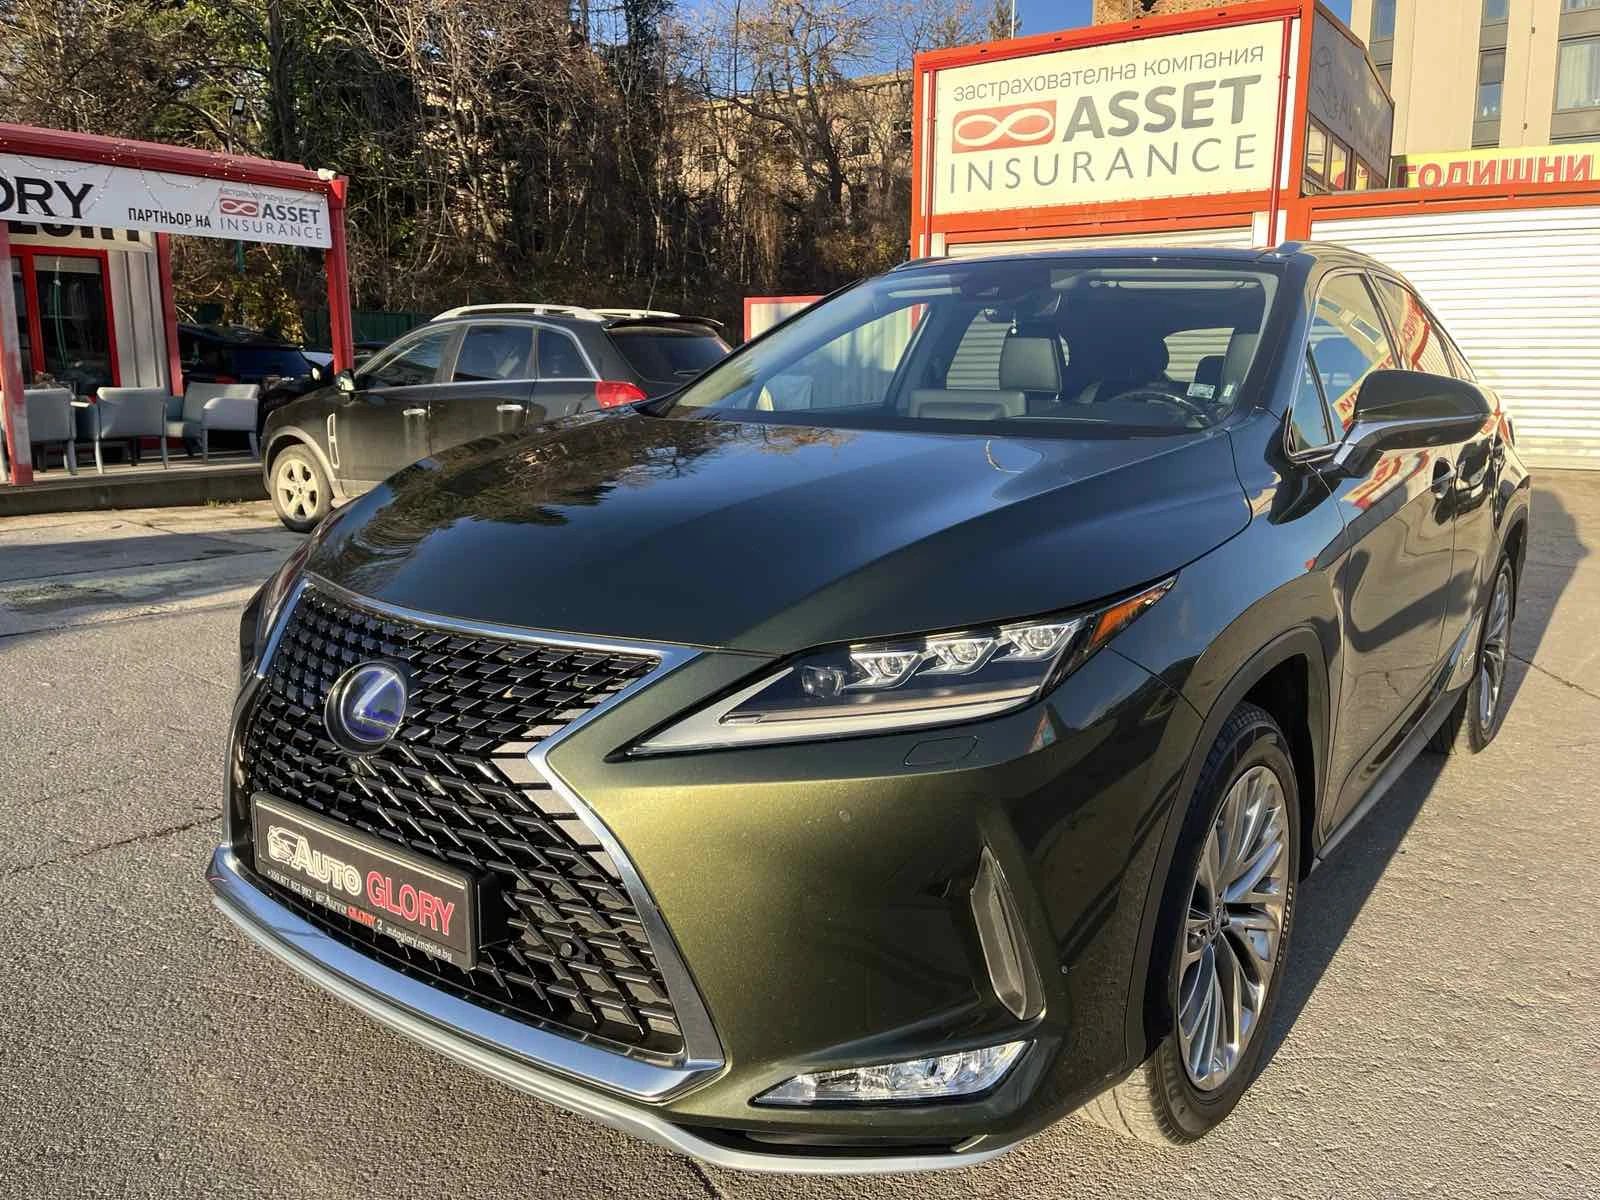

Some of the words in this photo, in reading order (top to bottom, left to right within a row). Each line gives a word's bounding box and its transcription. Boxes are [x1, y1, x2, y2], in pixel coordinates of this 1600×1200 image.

[952, 63, 1137, 102] застрахователна
[1143, 45, 1265, 77] компания
[1062, 74, 1262, 142] ASSET
[949, 134, 1258, 193] INSURANCE
[1399, 154, 1592, 188] ГОДИШНИ
[128, 208, 192, 226] ПАРТНЬОР
[196, 216, 212, 228] НА
[220, 217, 323, 240] INSURANCE
[262, 203, 321, 225] ASSET
[366, 871, 455, 937] GLORY
